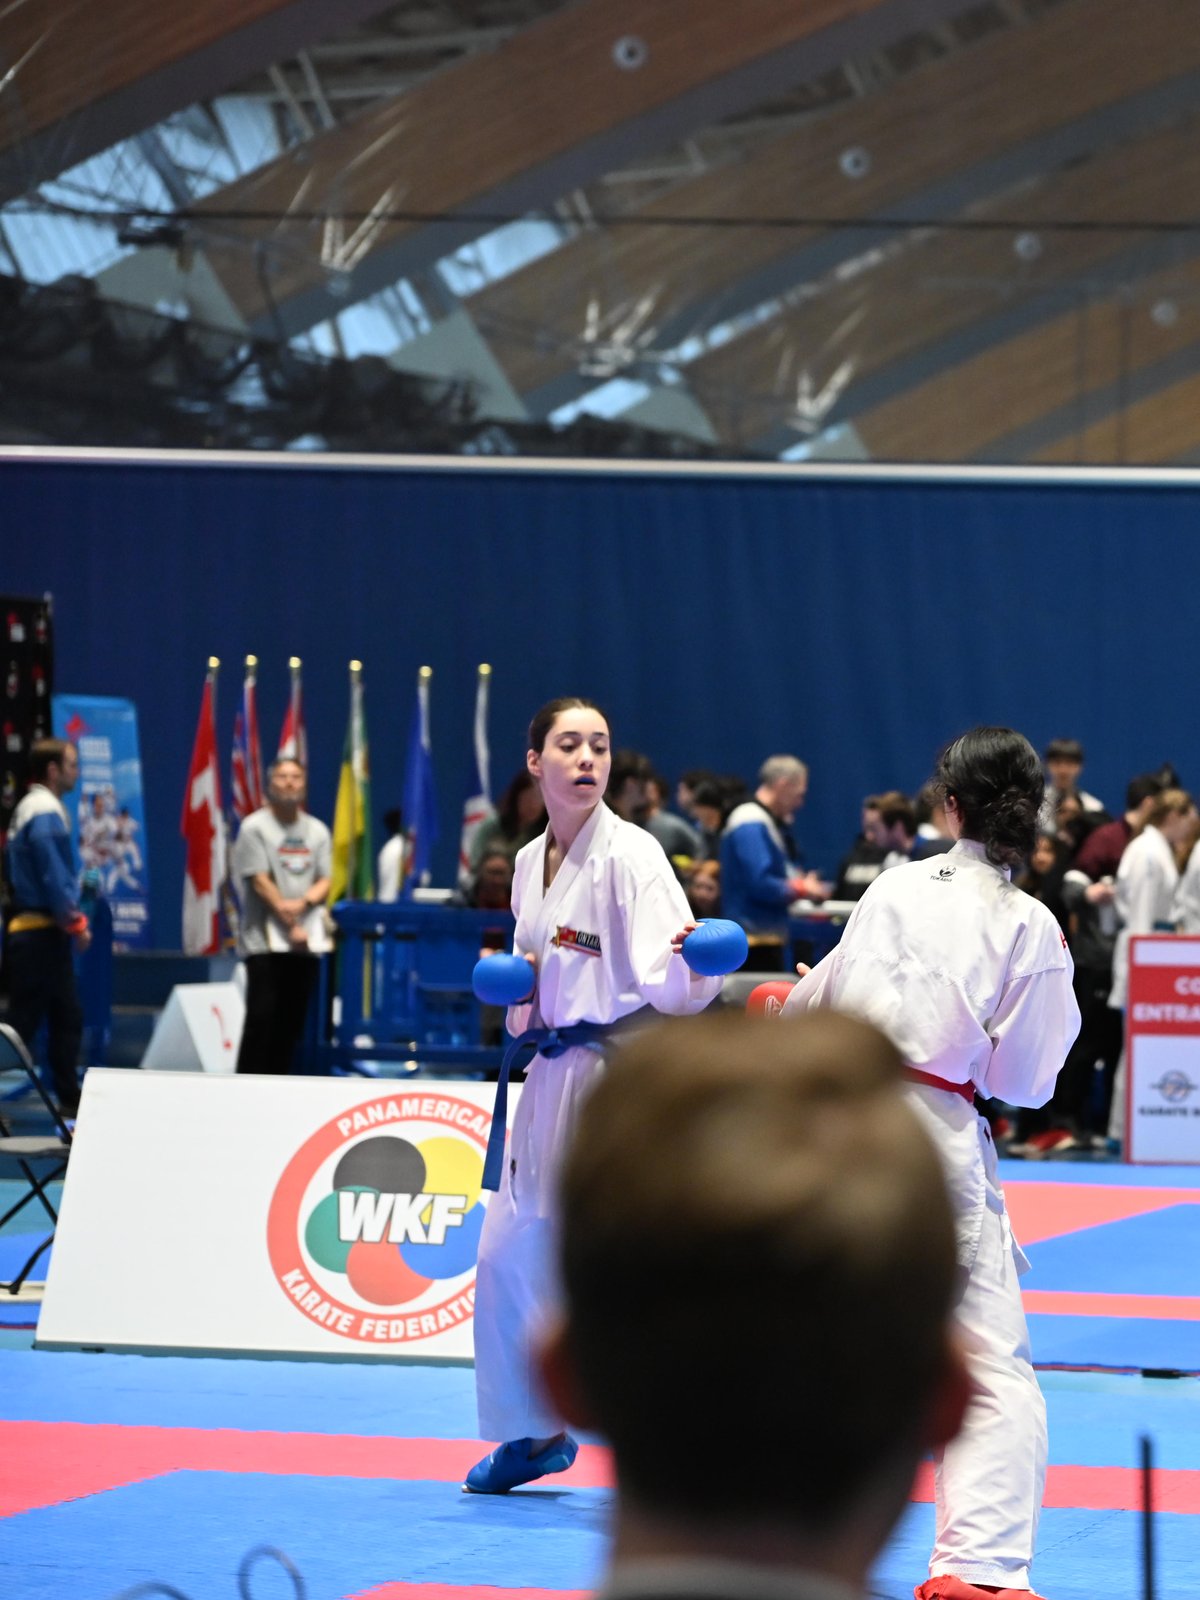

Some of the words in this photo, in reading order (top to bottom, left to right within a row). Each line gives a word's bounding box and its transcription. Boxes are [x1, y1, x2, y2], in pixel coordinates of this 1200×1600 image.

[577, 931, 601, 950] ONTAR
[337, 1190, 468, 1245] WKF
[281, 1268, 356, 1333] KARATE
[359, 1288, 476, 1340] FEDERATI
